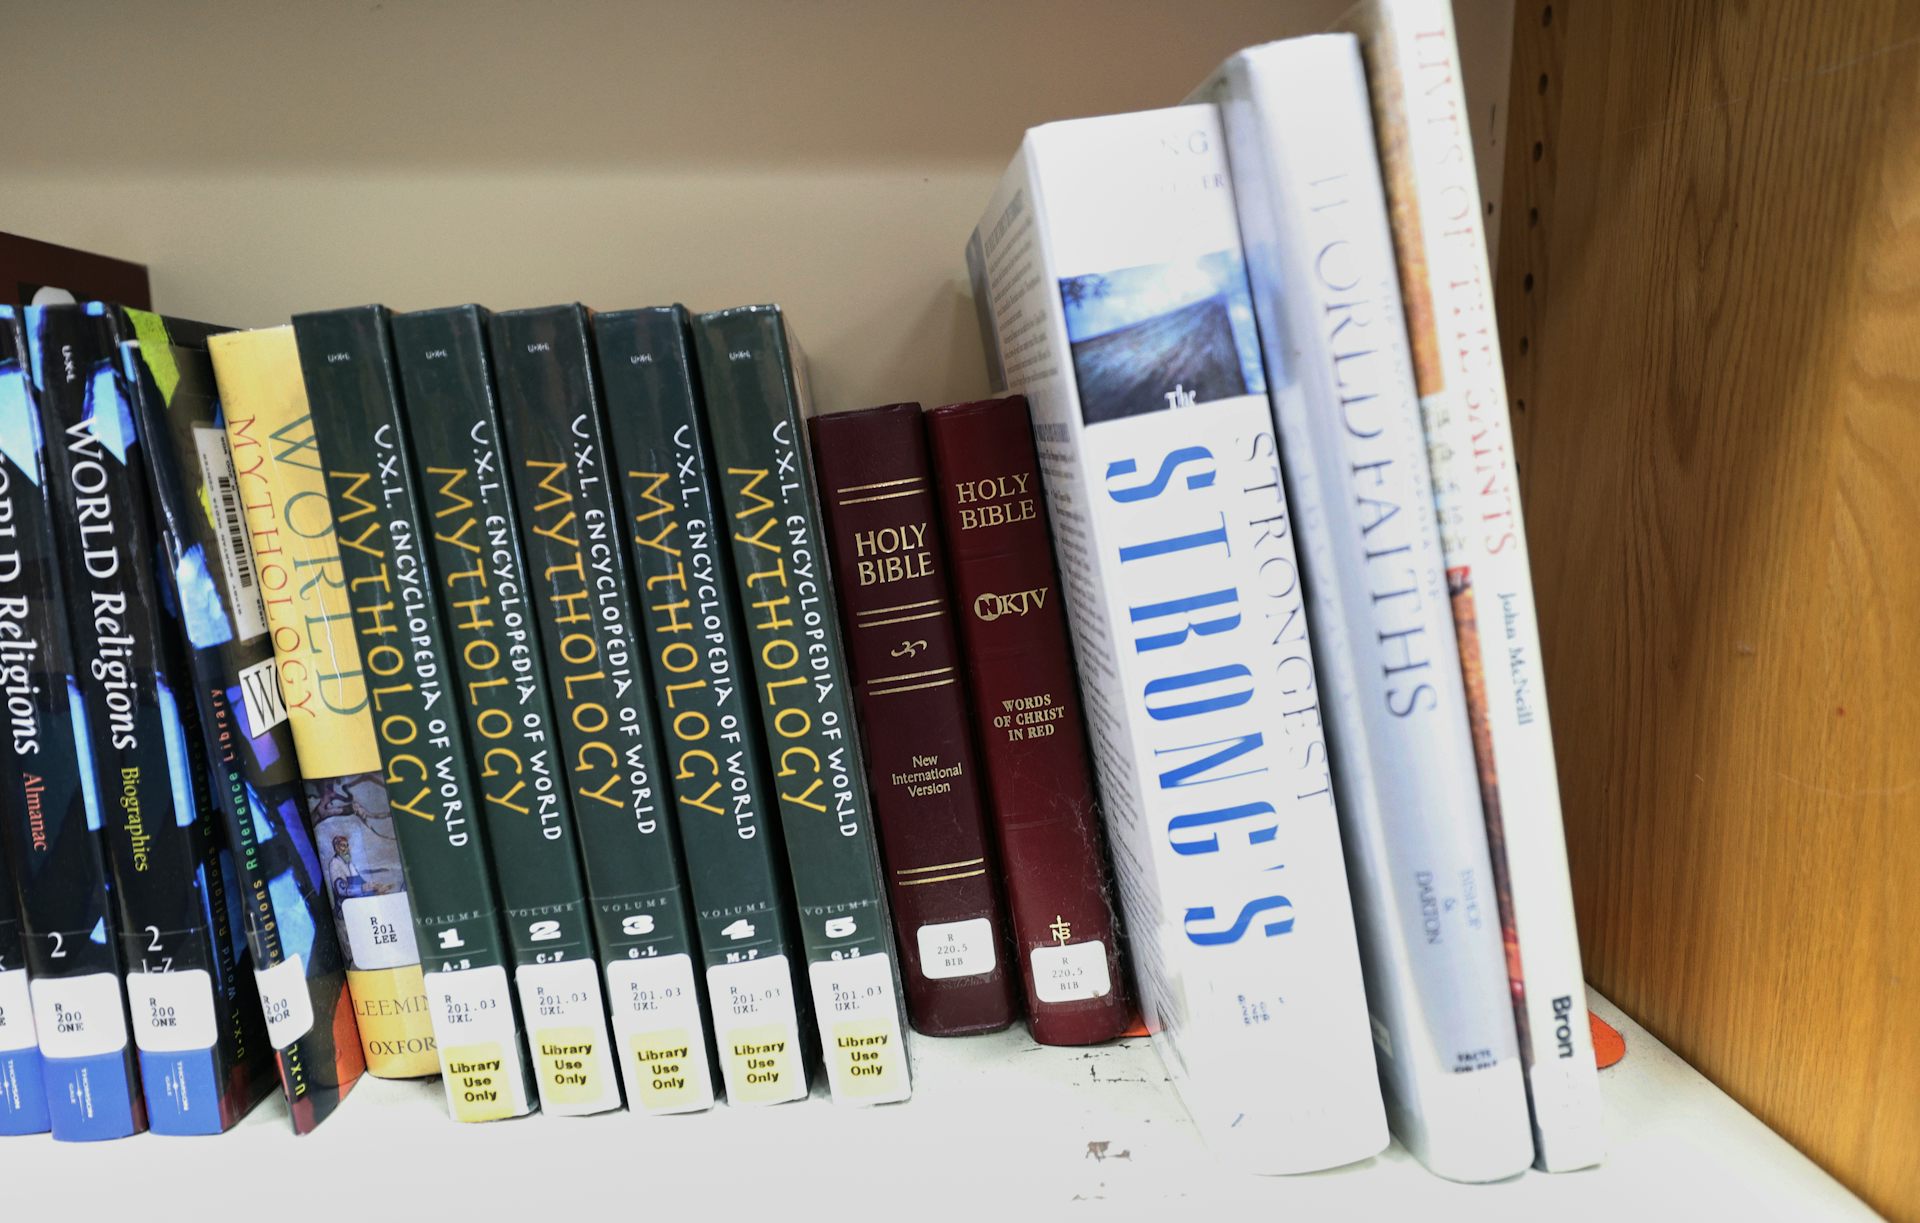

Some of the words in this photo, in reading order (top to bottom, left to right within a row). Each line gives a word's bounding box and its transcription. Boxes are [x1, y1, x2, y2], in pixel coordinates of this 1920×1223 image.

[374, 423, 403, 509] U.X.L.
[471, 420, 499, 504] U.X.L.
[571, 414, 599, 498] U.X.L.
[673, 424, 700, 508] U.X.L.
[772, 420, 799, 504] U.X.L.
[65, 416, 119, 580] WORLD
[956, 472, 1030, 504] HOLY
[959, 499, 1037, 530] BIBLE
[855, 522, 928, 557] HOLY
[228, 415, 316, 718] MYTHOLOGY
[268, 414, 369, 715] WORLD
[857, 551, 935, 586] BIBLE
[1352, 459, 1437, 719] FAITHS
[485, 515, 536, 705] ENCYCLOPEDIA
[584, 508, 632, 699] ENCYCLOPEDIA
[687, 519, 733, 707] ENCYCLOPEDIA
[786, 515, 834, 703] ENCYCLOPEDIA
[973, 587, 1049, 621] NKJV
[389, 519, 441, 711] ENCYCLOPEDIA
[1238, 432, 1333, 805] STRONGEST
[1497, 593, 1520, 639] John
[426, 467, 530, 815] MYTHOLOGY
[526, 460, 624, 809] MYTHOLOGY
[628, 471, 725, 816] MYTHOLOGY
[728, 468, 827, 813] MYTHOLOGY
[330, 471, 435, 821] MYTHOLOGY
[0, 595, 40, 755] Religions
[91, 591, 138, 751] Religions
[243, 664, 281, 728] W
[1001, 693, 1051, 713] WORDS
[1104, 445, 1296, 947] STRONG'S
[211, 688, 234, 762] Library
[619, 707, 640, 736] OF
[821, 711, 841, 740] OF
[993, 715, 1013, 729] OF
[1014, 705, 1065, 725] CHRIST
[428, 719, 450, 749] OF
[523, 713, 545, 743] OF
[720, 714, 741, 743] OF
[1008, 729, 1024, 742] IN
[1027, 723, 1055, 738] RED
[912, 755, 938, 767] New
[892, 763, 963, 786] International
[530, 750, 562, 840] WORLD
[625, 744, 656, 834] WORLD
[726, 751, 756, 840] WORLD
[828, 748, 858, 837] WORLD
[907, 781, 951, 798] Version
[23, 772, 47, 851] Almanac
[435, 756, 468, 847] WORLD
[120, 766, 149, 872] Biographies
[229, 771, 258, 871] Reference
[509, 903, 574, 918] VOLUME
[602, 898, 667, 913] VOLUME
[701, 901, 766, 919] VOLUME
[804, 900, 869, 916] VOLUME
[1414, 870, 1443, 946] DARTON
[1442, 897, 1456, 913] &
[370, 916, 378, 926] R
[415, 910, 481, 925] VOLUME
[621, 914, 655, 936] 3
[825, 916, 857, 939] 5
[144, 925, 163, 951] 2
[373, 923, 395, 935] 201
[437, 928, 465, 949] 1
[528, 920, 561, 942] 2
[721, 918, 755, 940] 4
[947, 933, 954, 942] R
[47, 931, 67, 958] 2
[374, 934, 398, 945] LEE
[937, 943, 968, 955] 220.5
[944, 956, 964, 967] BIB
[1062, 956, 1069, 965] R
[1051, 967, 1083, 978] 220.5
[537, 986, 545, 996] R
[630, 982, 638, 991] R
[633, 986, 681, 1001] 201.03
[730, 986, 738, 995] R
[832, 983, 840, 992] R
[834, 985, 883, 1002] 201.03
[1060, 981, 1079, 991] BIB
[149, 997, 156, 1006] R
[266, 998, 288, 1015] 200
[354, 994, 429, 1016] LEEMIN
[444, 994, 452, 1003] R
[447, 999, 496, 1014] 201.03
[539, 991, 588, 1006] 201.03
[633, 1001, 658, 1012] UXL
[732, 988, 781, 1005] 201.03
[835, 1001, 860, 1012] UXL
[55, 1003, 62, 1012] R
[57, 1011, 82, 1023] 200
[151, 1006, 175, 1017] 200
[266, 1009, 290, 1025] WOR
[539, 1006, 565, 1016] UXL
[733, 1004, 758, 1015] UXL
[57, 1022, 84, 1033] ONE
[151, 1017, 177, 1027] ONE
[448, 1013, 473, 1024] UXL
[369, 1036, 437, 1056] OXFOR
[542, 1044, 592, 1056] Library
[734, 1041, 785, 1056] Library
[837, 1034, 888, 1048] Library
[554, 1059, 582, 1070] Use
[637, 1047, 688, 1062] Library
[747, 1059, 775, 1070] Use
[851, 1051, 878, 1062] Use
[449, 1059, 500, 1075] Library
[651, 1064, 679, 1075] Use
[850, 1065, 883, 1077] Only
[177, 1060, 189, 1112] THOMSON
[463, 1077, 492, 1088] Use
[554, 1073, 587, 1086] Only
[652, 1078, 685, 1090] Only
[746, 1072, 779, 1084] Only
[81, 1067, 94, 1119] THOMSON
[464, 1090, 497, 1103] Only
